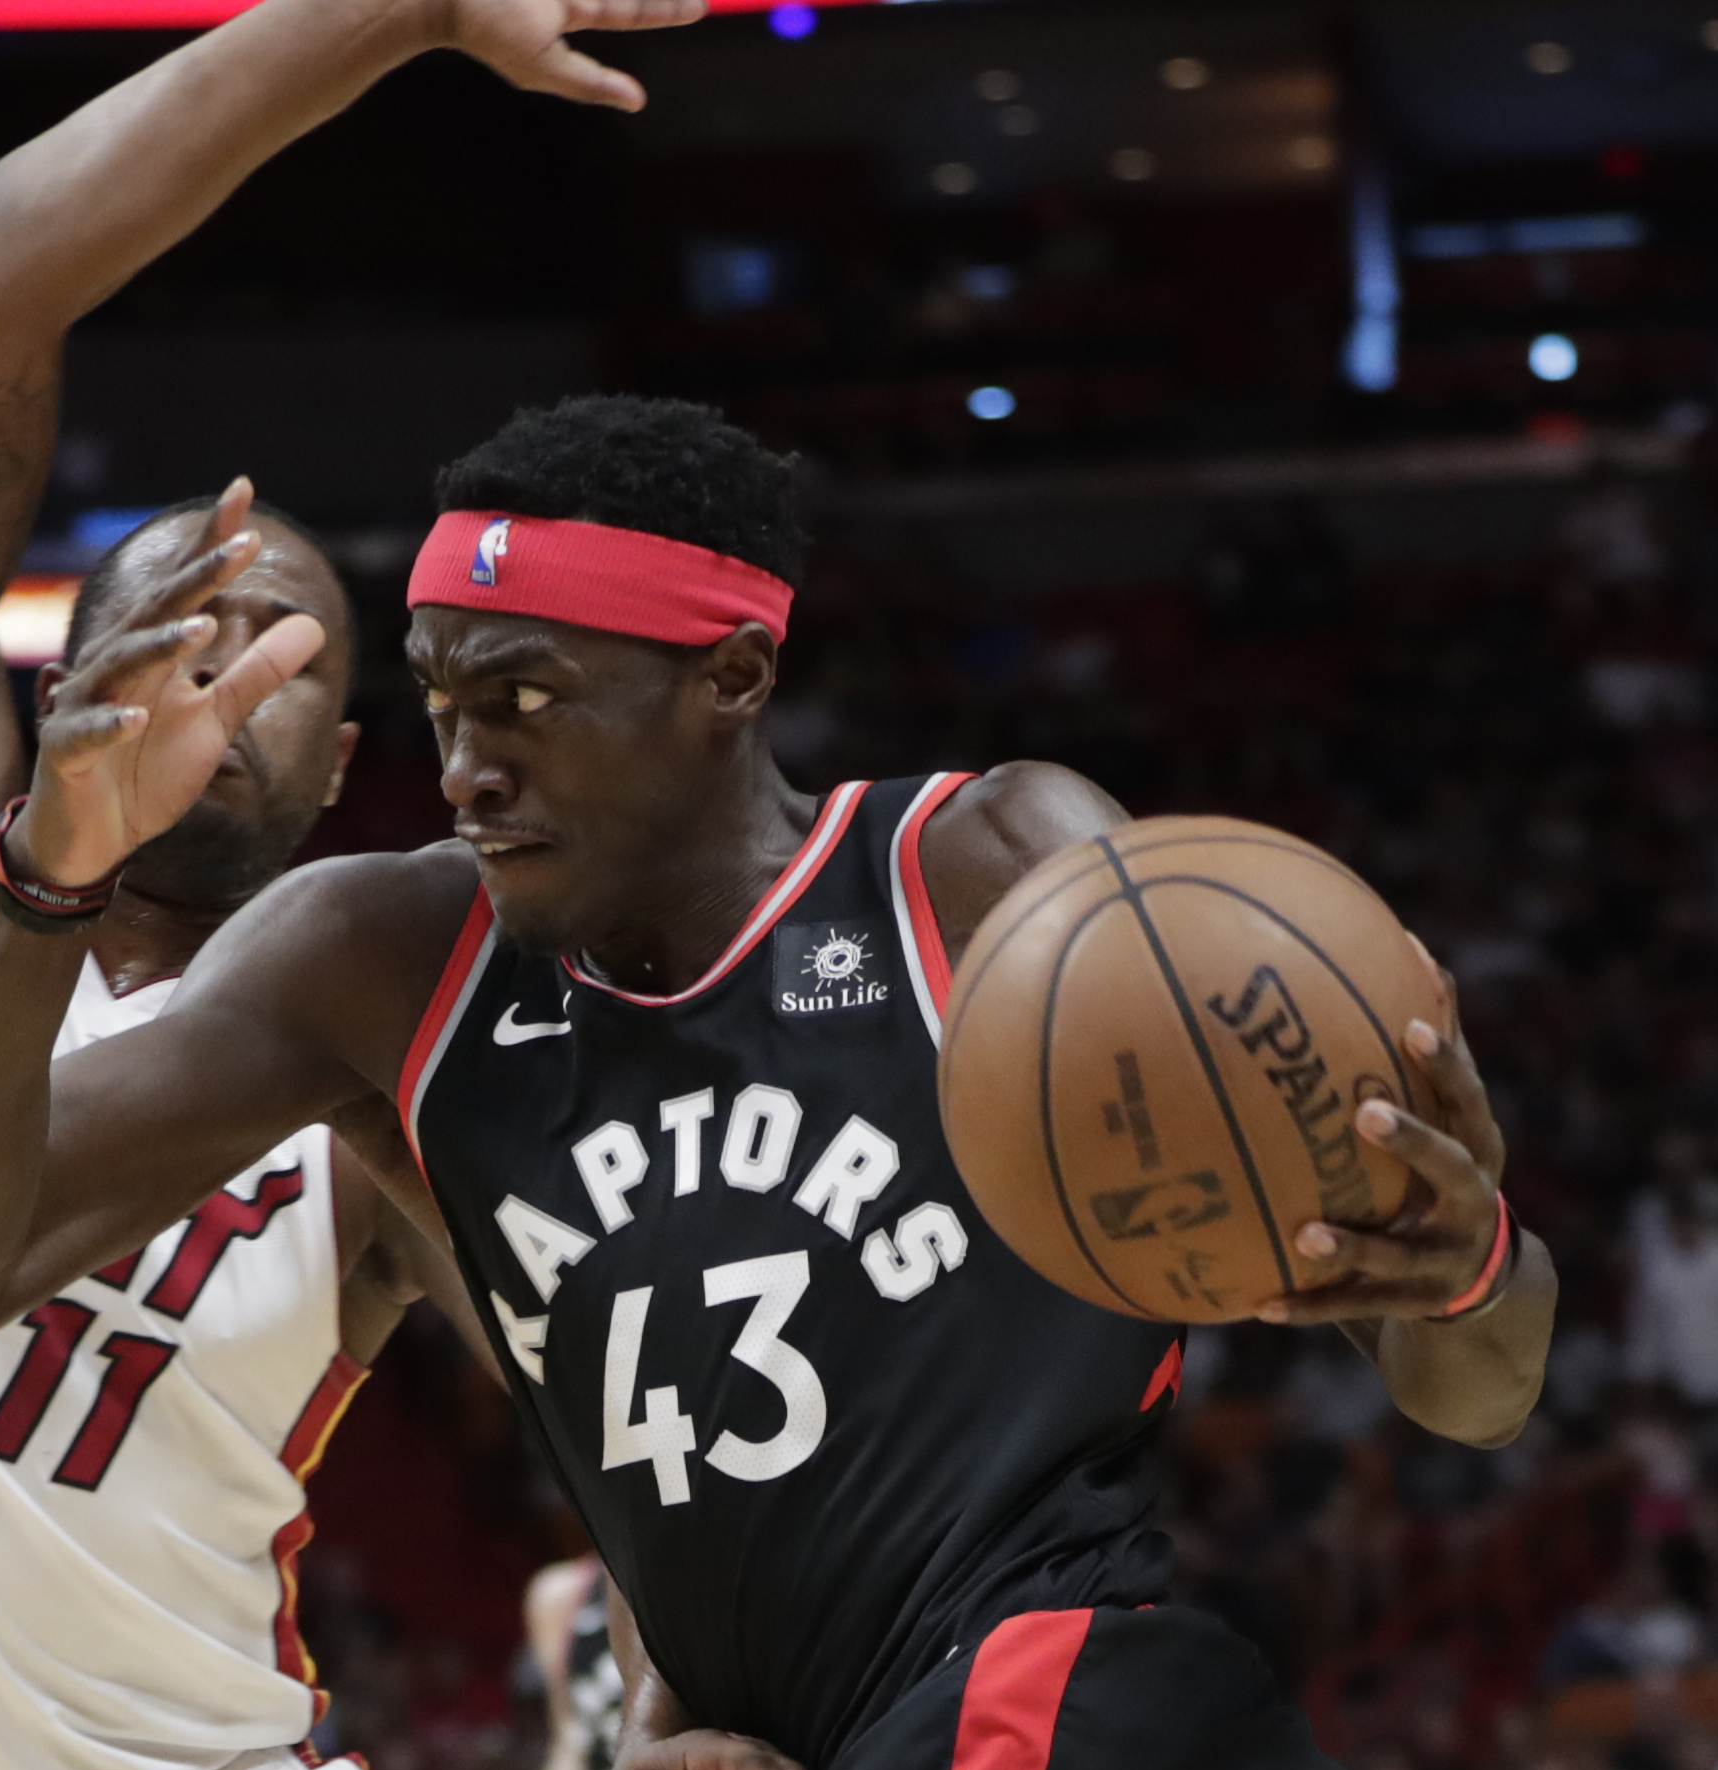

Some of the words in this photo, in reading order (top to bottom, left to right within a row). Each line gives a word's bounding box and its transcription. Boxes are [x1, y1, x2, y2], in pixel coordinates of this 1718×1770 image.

[781, 991, 833, 1012] Sun
[840, 981, 888, 1007] Life
[601, 1249, 827, 1507] 43
